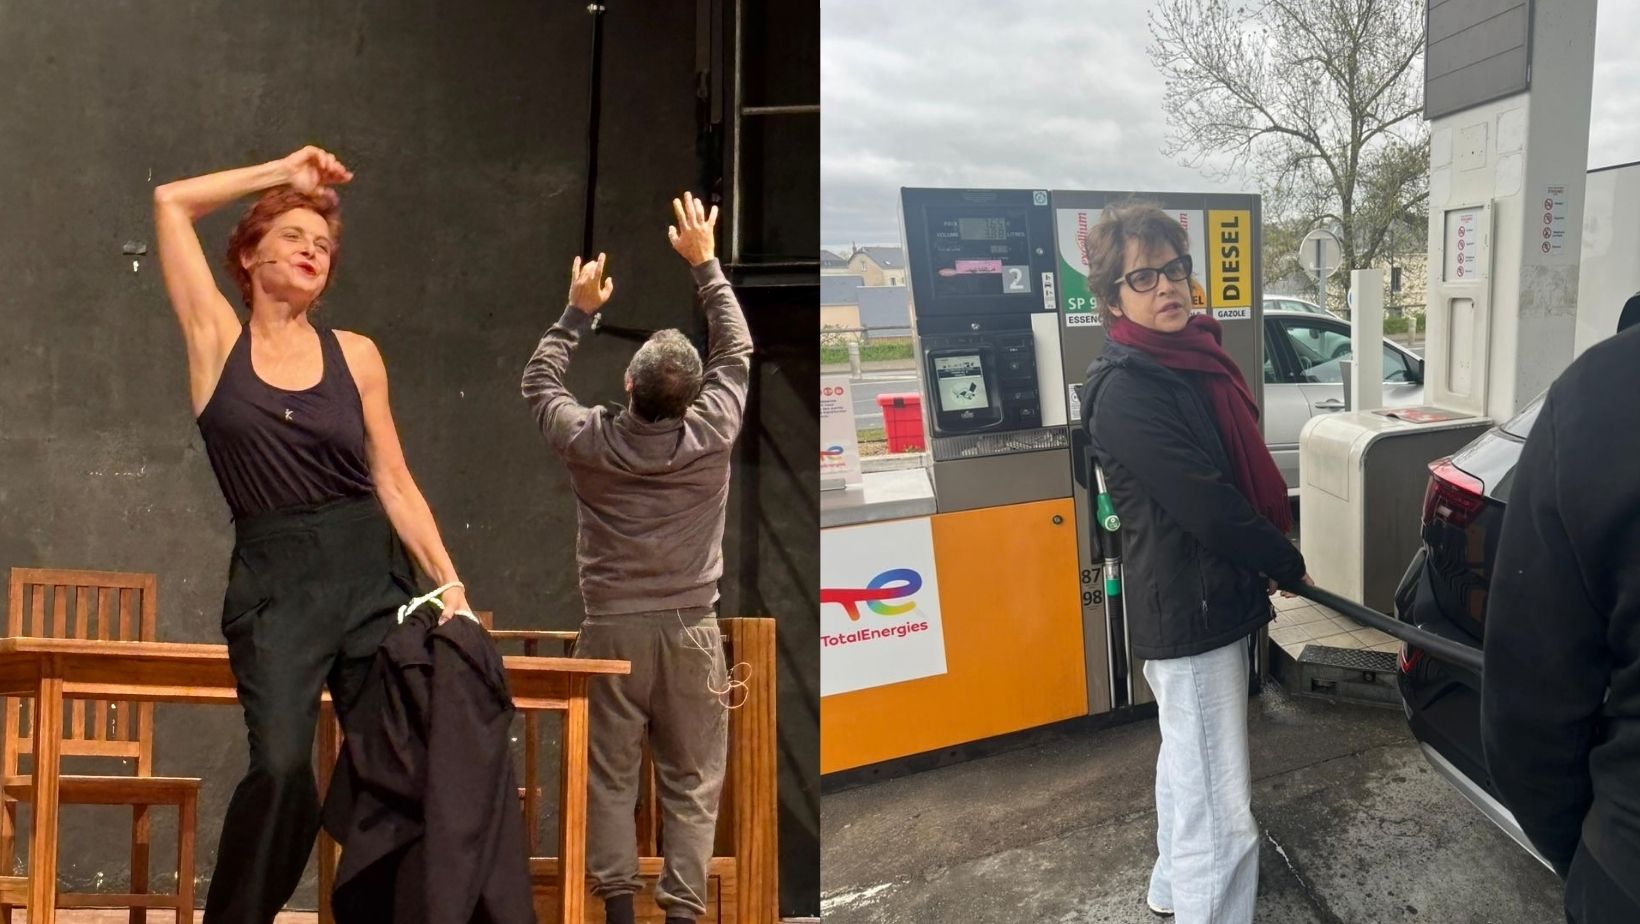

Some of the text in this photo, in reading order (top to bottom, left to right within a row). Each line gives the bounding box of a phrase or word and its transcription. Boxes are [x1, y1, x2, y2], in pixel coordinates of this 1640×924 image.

[1220, 216, 1240, 300] DIESEL
[1008, 267, 1025, 290] 2
[1068, 297, 1085, 310] SP
[1089, 296, 1098, 310] 9
[1068, 315, 1103, 324] ESSENC
[1217, 310, 1246, 318] GAZOLE
[1081, 567, 1101, 584] 87
[1083, 590, 1102, 606] 98
[820, 621, 928, 648] TotalEnergies
